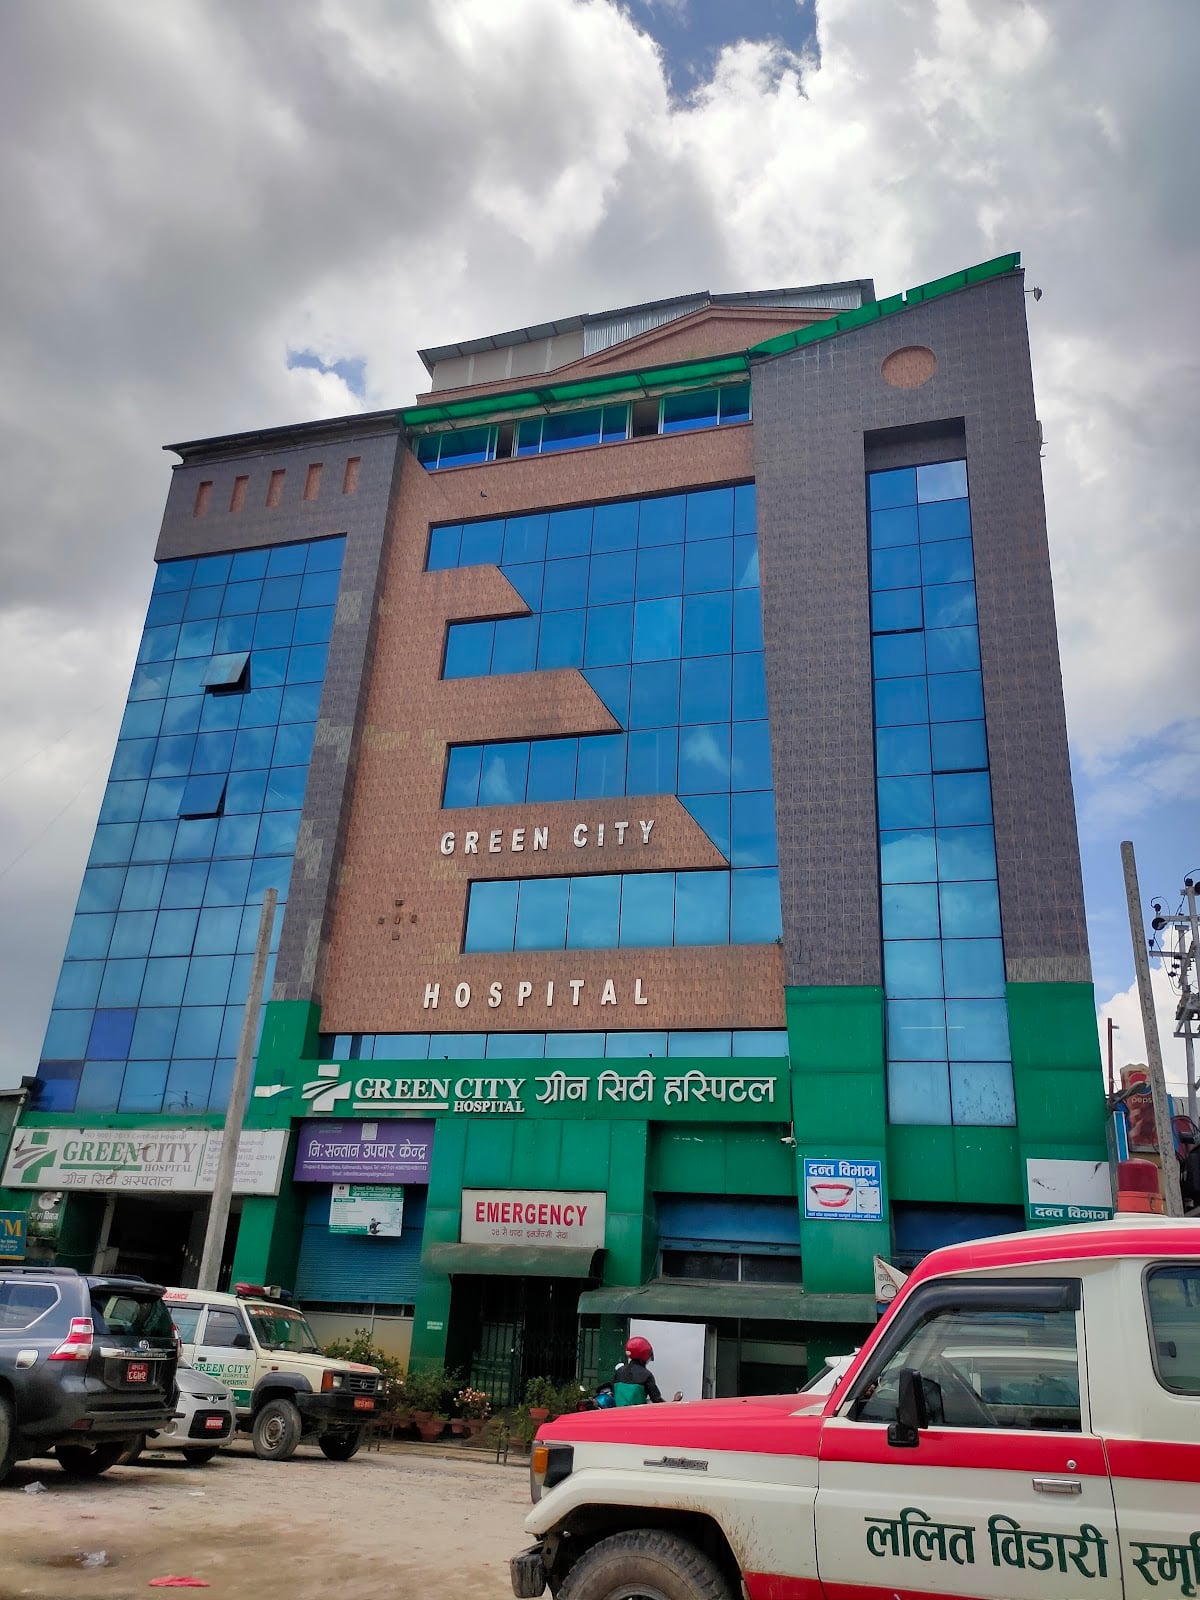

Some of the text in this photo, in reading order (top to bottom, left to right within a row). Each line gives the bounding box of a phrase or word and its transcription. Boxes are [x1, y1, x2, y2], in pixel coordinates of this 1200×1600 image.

[440, 819, 656, 856] GREEN CITY
[423, 978, 649, 1009] HOSPITAL
[354, 1077, 527, 1100] GREEN CITY
[535, 1069, 778, 1106] ग्रीन सिटी हस्पिटल
[453, 1101, 526, 1113] HOSPITAL
[1131, 1097, 1154, 1105] peps
[63, 1141, 197, 1164] GREEN CITY
[363, 1143, 397, 1159] उपचार
[399, 1139, 428, 1161] केन्द्र
[144, 1164, 193, 1173] HOSPITAL
[808, 1161, 877, 1178] दन्त विभाग
[62, 1172, 174, 1188] ग्रीन सिटी अस्पताल
[475, 1201, 588, 1228] EMERGENCY
[1034, 1206, 1110, 1221] दन्त विभाग
[192, 1362, 251, 1374] GREEN CITY
[864, 1506, 976, 1566] ललित
[987, 1513, 1109, 1579] विडारी
